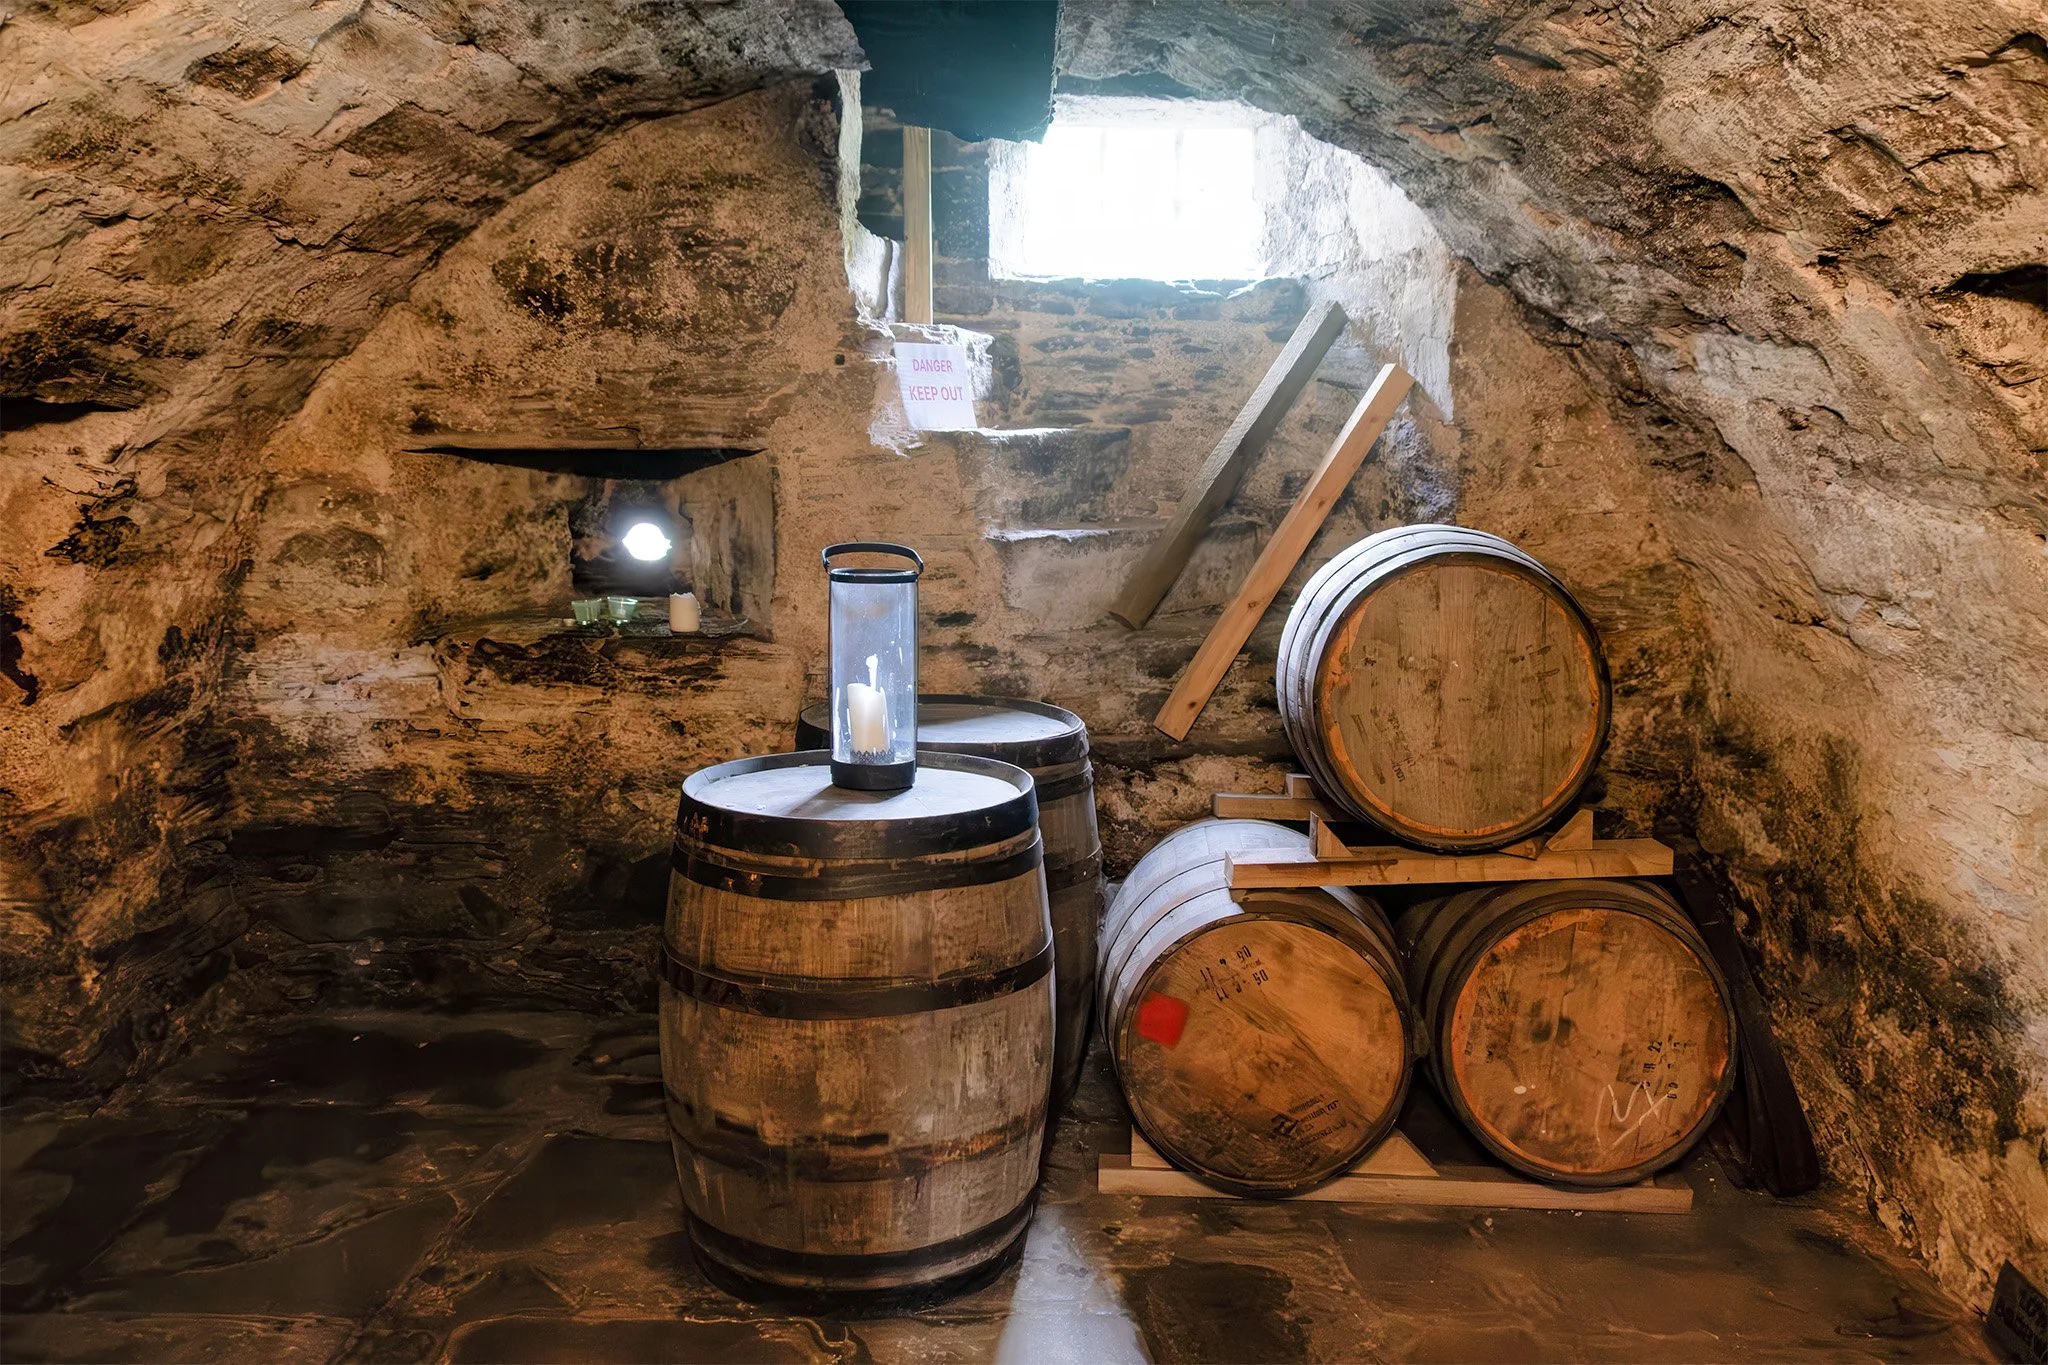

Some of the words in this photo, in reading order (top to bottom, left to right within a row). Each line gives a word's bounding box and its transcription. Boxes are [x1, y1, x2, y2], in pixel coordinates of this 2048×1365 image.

[912, 359, 953, 372] DANGER
[908, 386, 938, 401] KEEP
[940, 386, 963, 401] OUT
